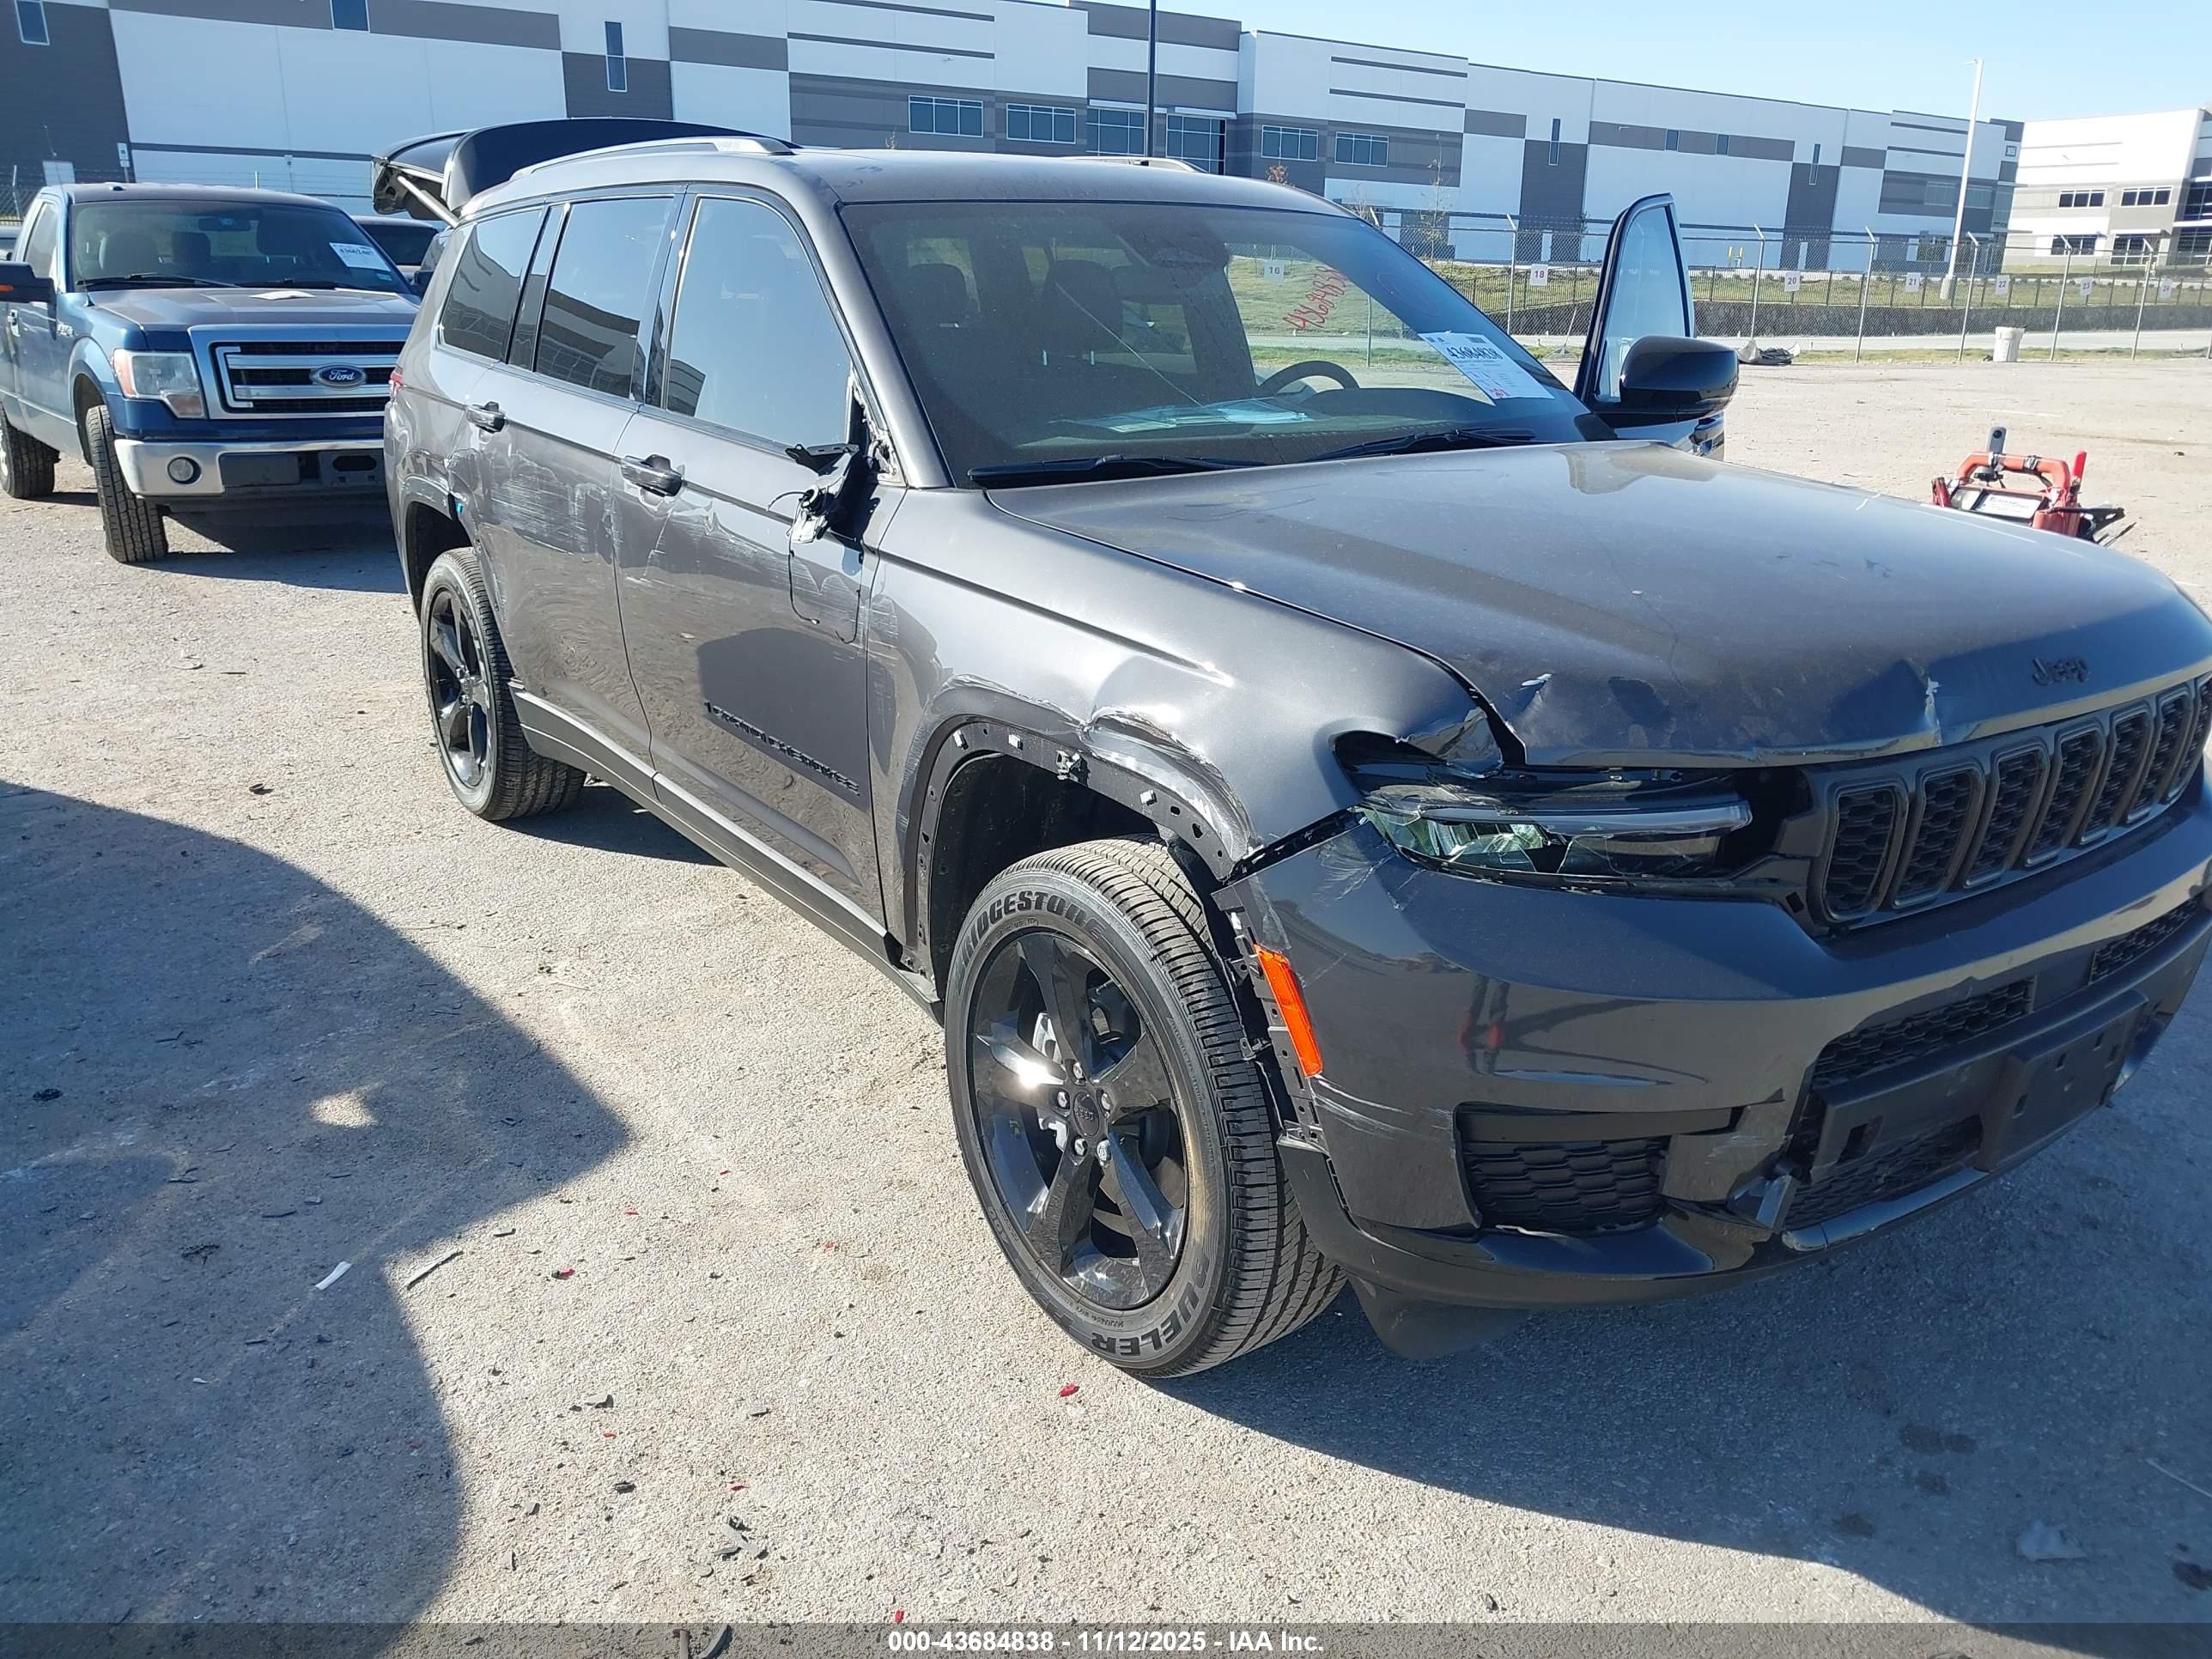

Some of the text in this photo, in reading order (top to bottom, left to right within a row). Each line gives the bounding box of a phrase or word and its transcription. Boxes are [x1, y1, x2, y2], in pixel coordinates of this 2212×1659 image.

[1268, 265, 1281, 276] 16
[1534, 270, 1546, 279] 18
[1787, 276, 1797, 285] 20
[1909, 277, 1917, 286] 21
[1998, 280, 2007, 289] 22
[1446, 347, 1504, 360] 43684838
[329, 369, 356, 380] Ford
[2032, 658, 2088, 687] Jeep
[955, 890, 1107, 994] BRIDGESTONE
